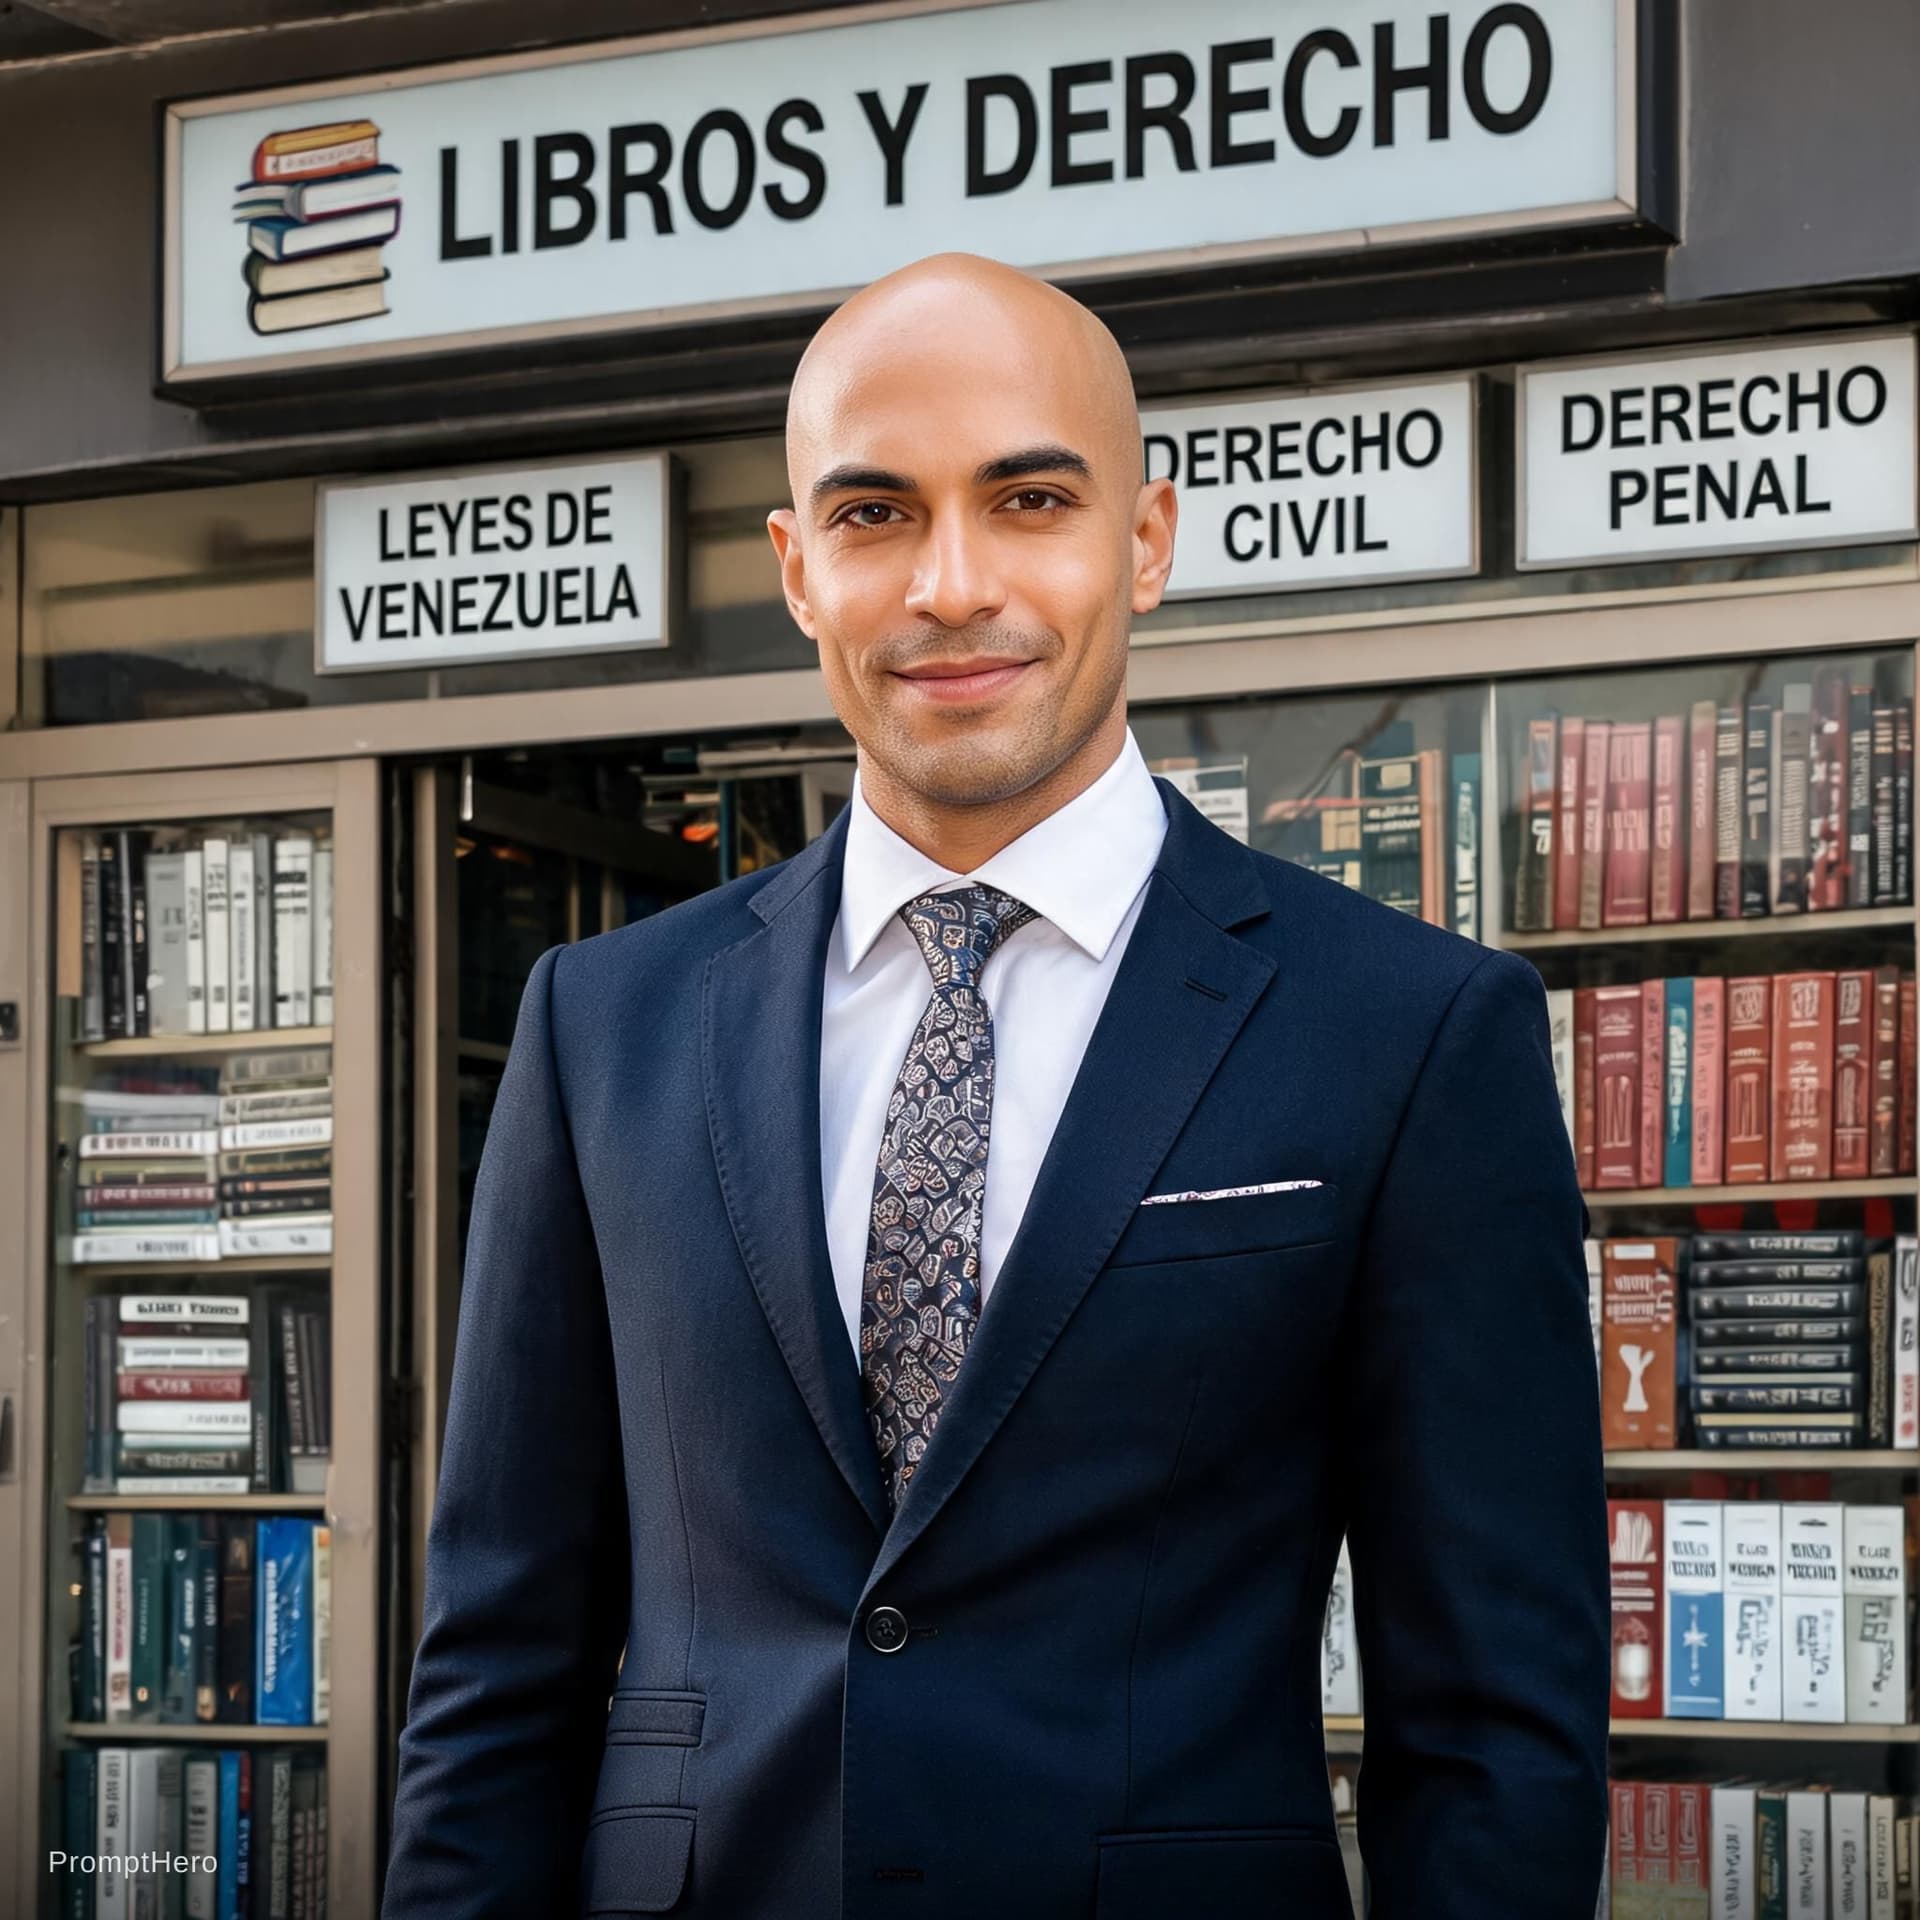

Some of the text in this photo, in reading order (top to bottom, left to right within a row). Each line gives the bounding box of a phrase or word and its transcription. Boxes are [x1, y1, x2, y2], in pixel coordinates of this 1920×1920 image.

[440, 2, 1553, 262] LIBROS Y DERECHO
[1143, 408, 1443, 489] DERECHO
[1561, 364, 1887, 454] DERECHO
[378, 484, 613, 563] LEYES DE
[1223, 495, 1388, 563] CIVIL
[1610, 454, 1831, 530] PENAL
[339, 563, 640, 642] VENEZUELA
